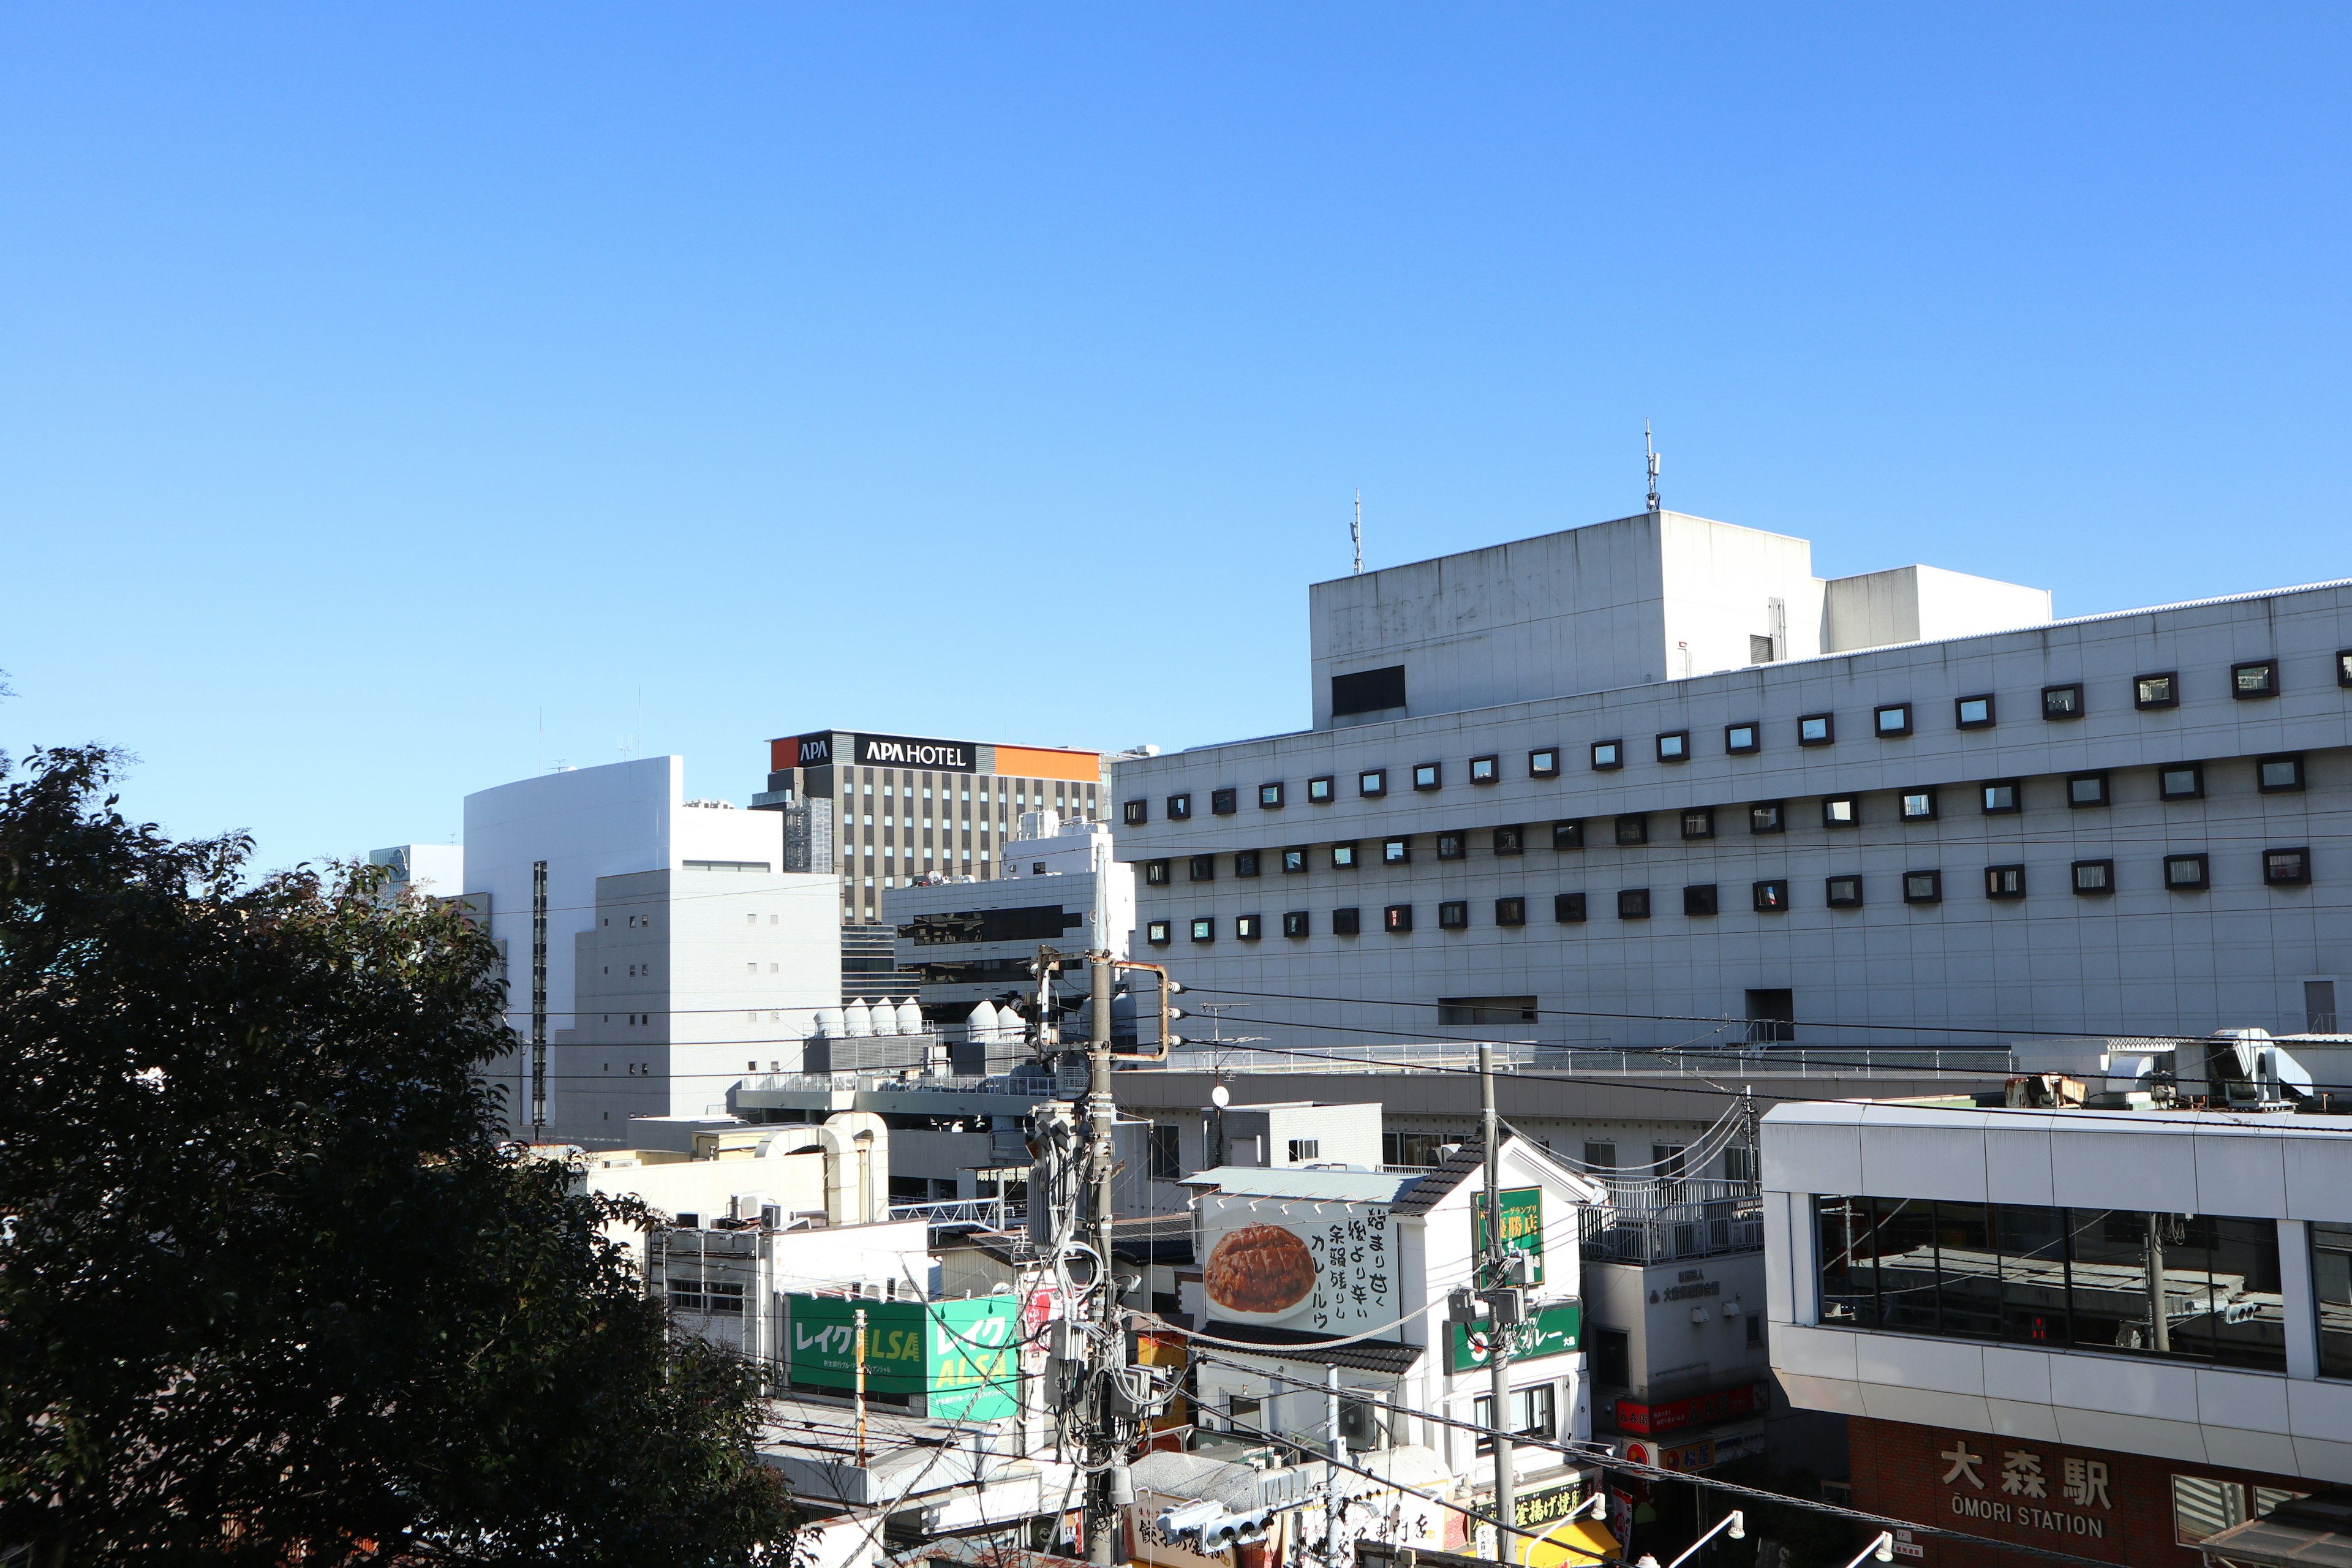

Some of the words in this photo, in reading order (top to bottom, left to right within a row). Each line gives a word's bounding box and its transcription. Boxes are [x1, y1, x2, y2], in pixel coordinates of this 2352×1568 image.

[800, 740, 828, 761] APA
[866, 741, 905, 762] APA
[906, 744, 967, 767] HOTEL
[1329, 1224, 1348, 1319] 余韻残りし
[1348, 1219, 1368, 1318] 後より辛い
[1367, 1208, 1388, 1306] 始まり甘く
[1311, 1235, 1328, 1329] カレールウ
[937, 1316, 1006, 1356] レイク
[1562, 1336, 1575, 1347] 大森
[934, 1351, 1008, 1389] ALSA
[1683, 1444, 1709, 1469] 松屋
[1940, 1441, 2113, 1511] 大森駅
[1951, 1491, 2012, 1523] ŌMORI
[2017, 1506, 2104, 1539] STATION
